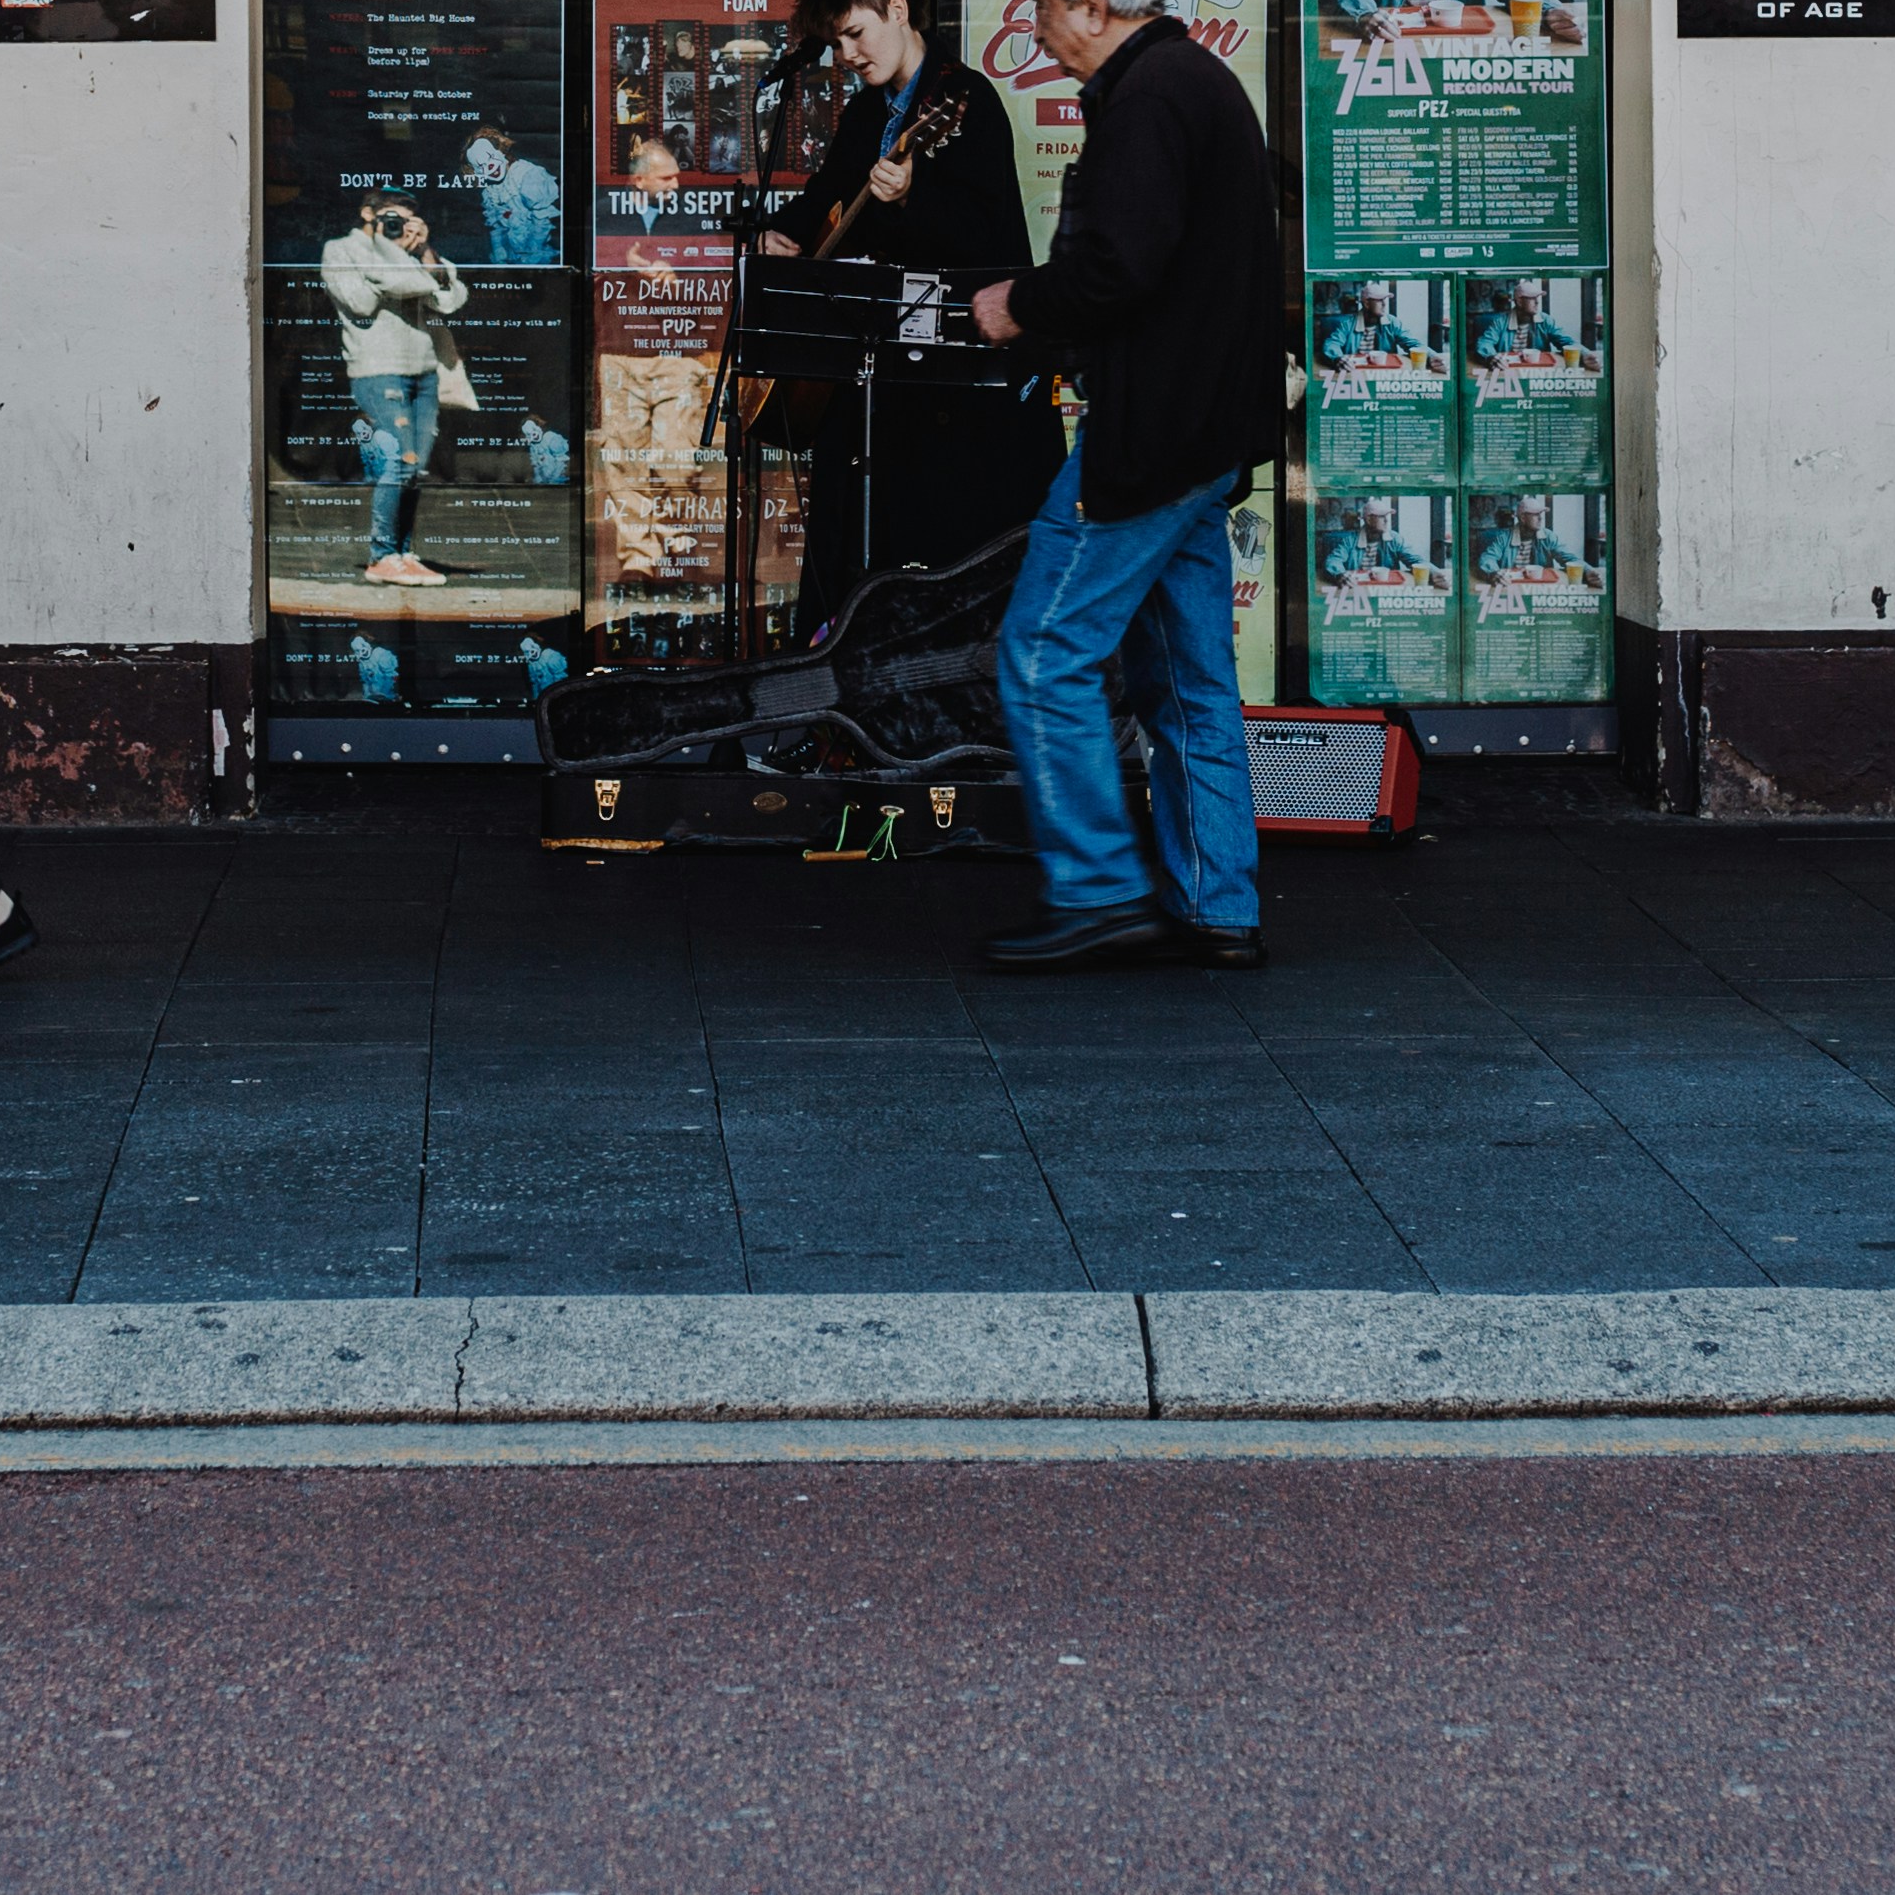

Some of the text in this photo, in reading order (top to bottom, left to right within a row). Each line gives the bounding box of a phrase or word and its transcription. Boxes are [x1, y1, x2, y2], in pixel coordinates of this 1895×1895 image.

[1757, 2, 1863, 18] OF AGE
[367, 14, 384, 23] The
[388, 14, 425, 23] Haunted
[429, 14, 445, 24] Big
[449, 14, 475, 23] House
[368, 46, 393, 55] Dress
[397, 48, 408, 57] up
[412, 46, 427, 55] for
[1331, 37, 1551, 115] 360 VINTAGE
[1443, 58, 1574, 81] MODERN
[368, 90, 409, 100] Saturday
[412, 90, 434, 98] 27th
[437, 90, 472, 99] October
[1443, 81, 1574, 95] REGIONAL TOUR
[1387, 100, 1506, 118] SUPPORT PEZ SPECIAL GUESTS
[368, 112, 480, 123] Doors open exactly 8PM
[340, 174, 488, 189] DON'T BE LATE
[608, 191, 734, 215] THU 13 SEPT
[1258, 732, 1325, 745] CUBE
